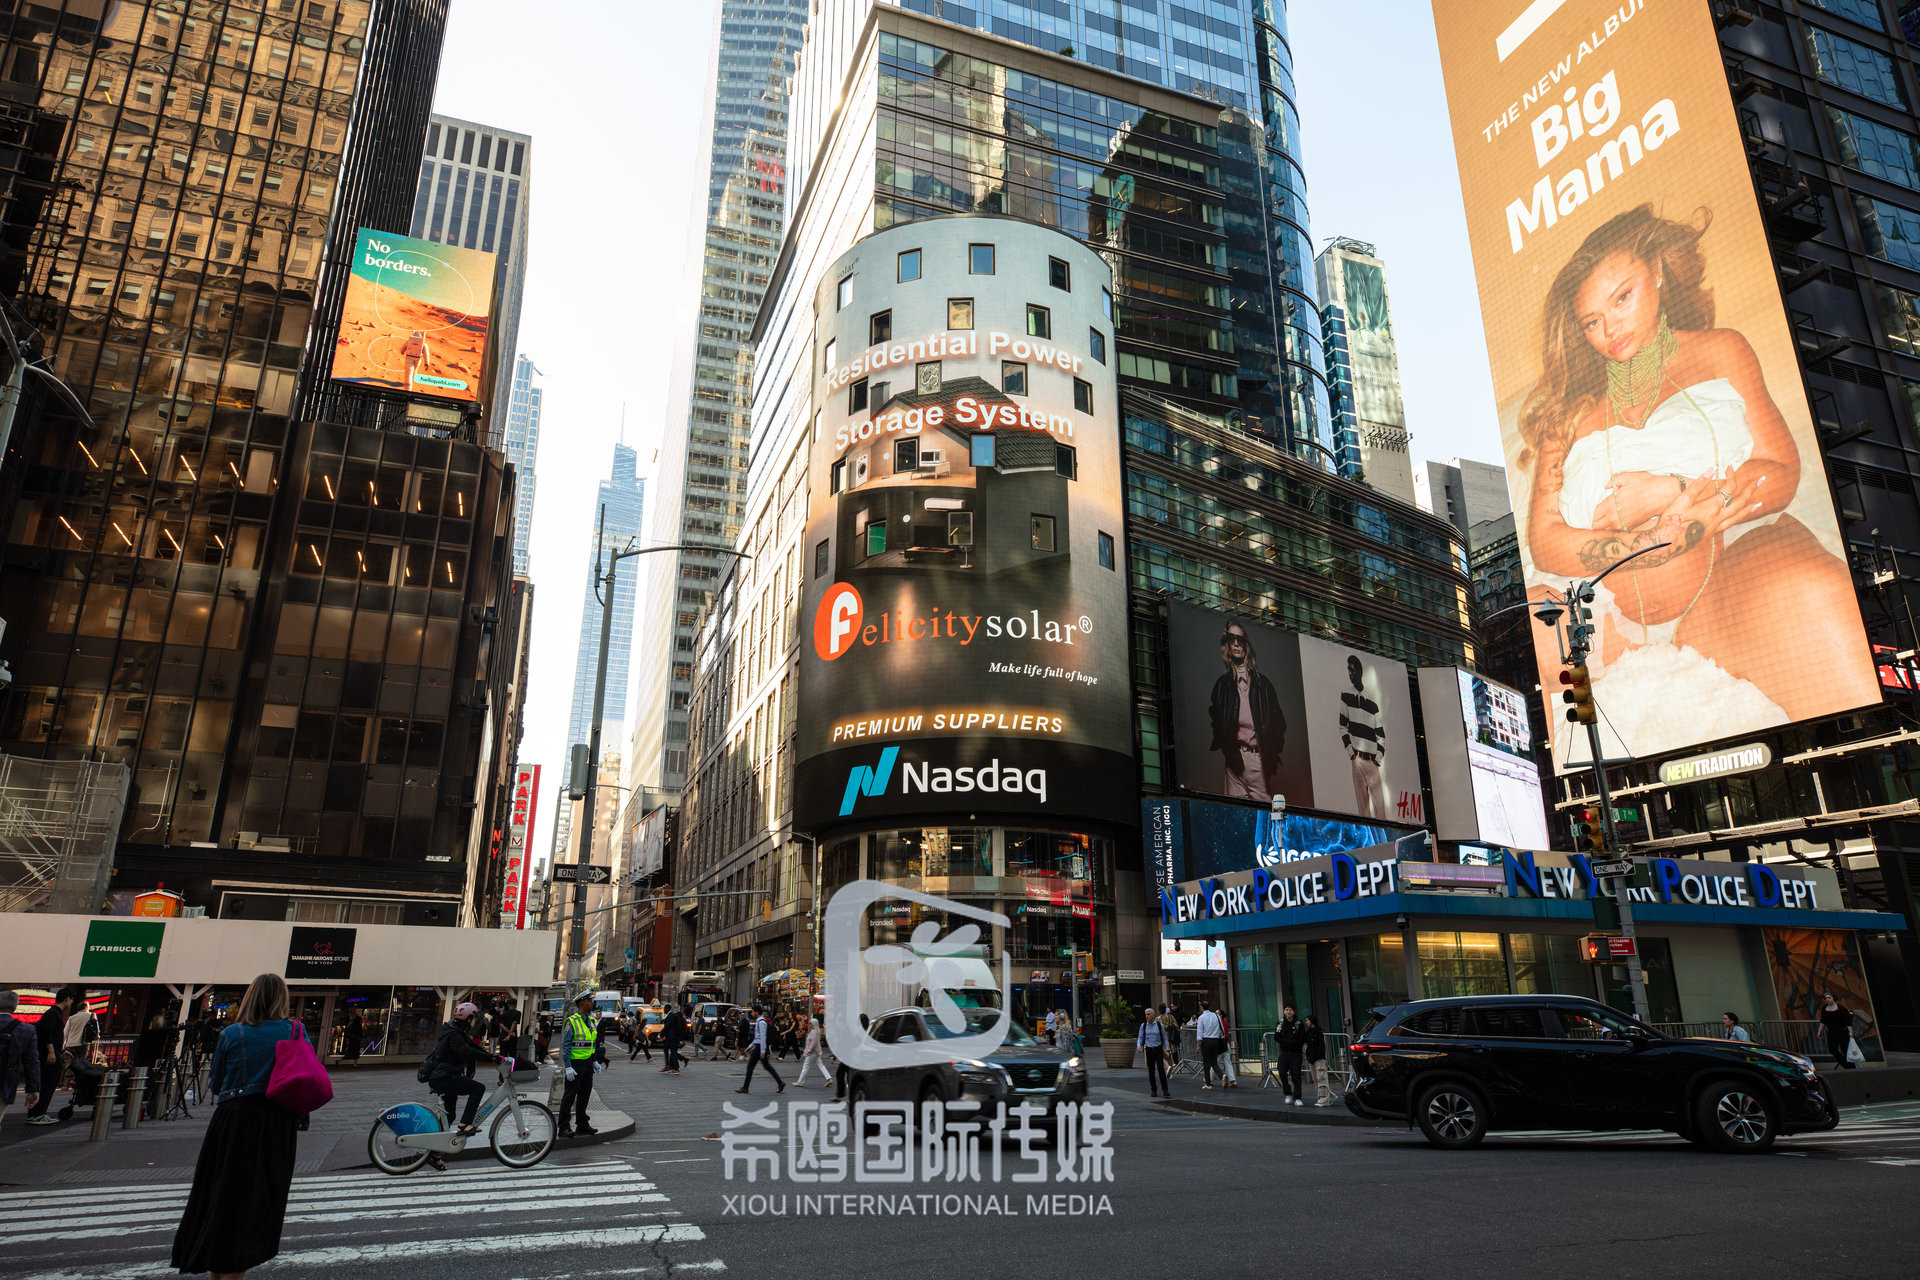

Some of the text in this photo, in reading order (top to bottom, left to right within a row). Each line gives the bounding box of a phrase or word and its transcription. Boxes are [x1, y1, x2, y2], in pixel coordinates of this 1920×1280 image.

[1482, 102, 1521, 143] THE
[1522, 53, 1572, 111] NEW
[1530, 69, 1621, 169] Big
[1505, 98, 1681, 255] Mama
[364, 253, 432, 277] borders.
[367, 239, 391, 254] No
[825, 329, 1083, 394] Residential Power
[835, 397, 1074, 451] Storage System
[988, 661, 1098, 686] Make life full of hope
[833, 713, 1063, 743] PREMIUM SUPPLIERS
[513, 772, 531, 825] PARK
[902, 758, 1047, 804] Nasdaq
[1396, 790, 1422, 822] H&M
[1152, 806, 1164, 867] AMERICAN
[1164, 827, 1172, 844] INC.
[503, 857, 521, 913] PARK
[1160, 853, 1397, 925] NEW YORK POLICE DEPT
[1502, 849, 1576, 898] NEW
[1654, 858, 1750, 906] POLICE
[1748, 864, 1817, 909] DEPT
[1595, 863, 1628, 874] ONE WAY
[1026, 906, 1047, 914] Nasdaq
[89, 945, 142, 953] STARBUCKS
